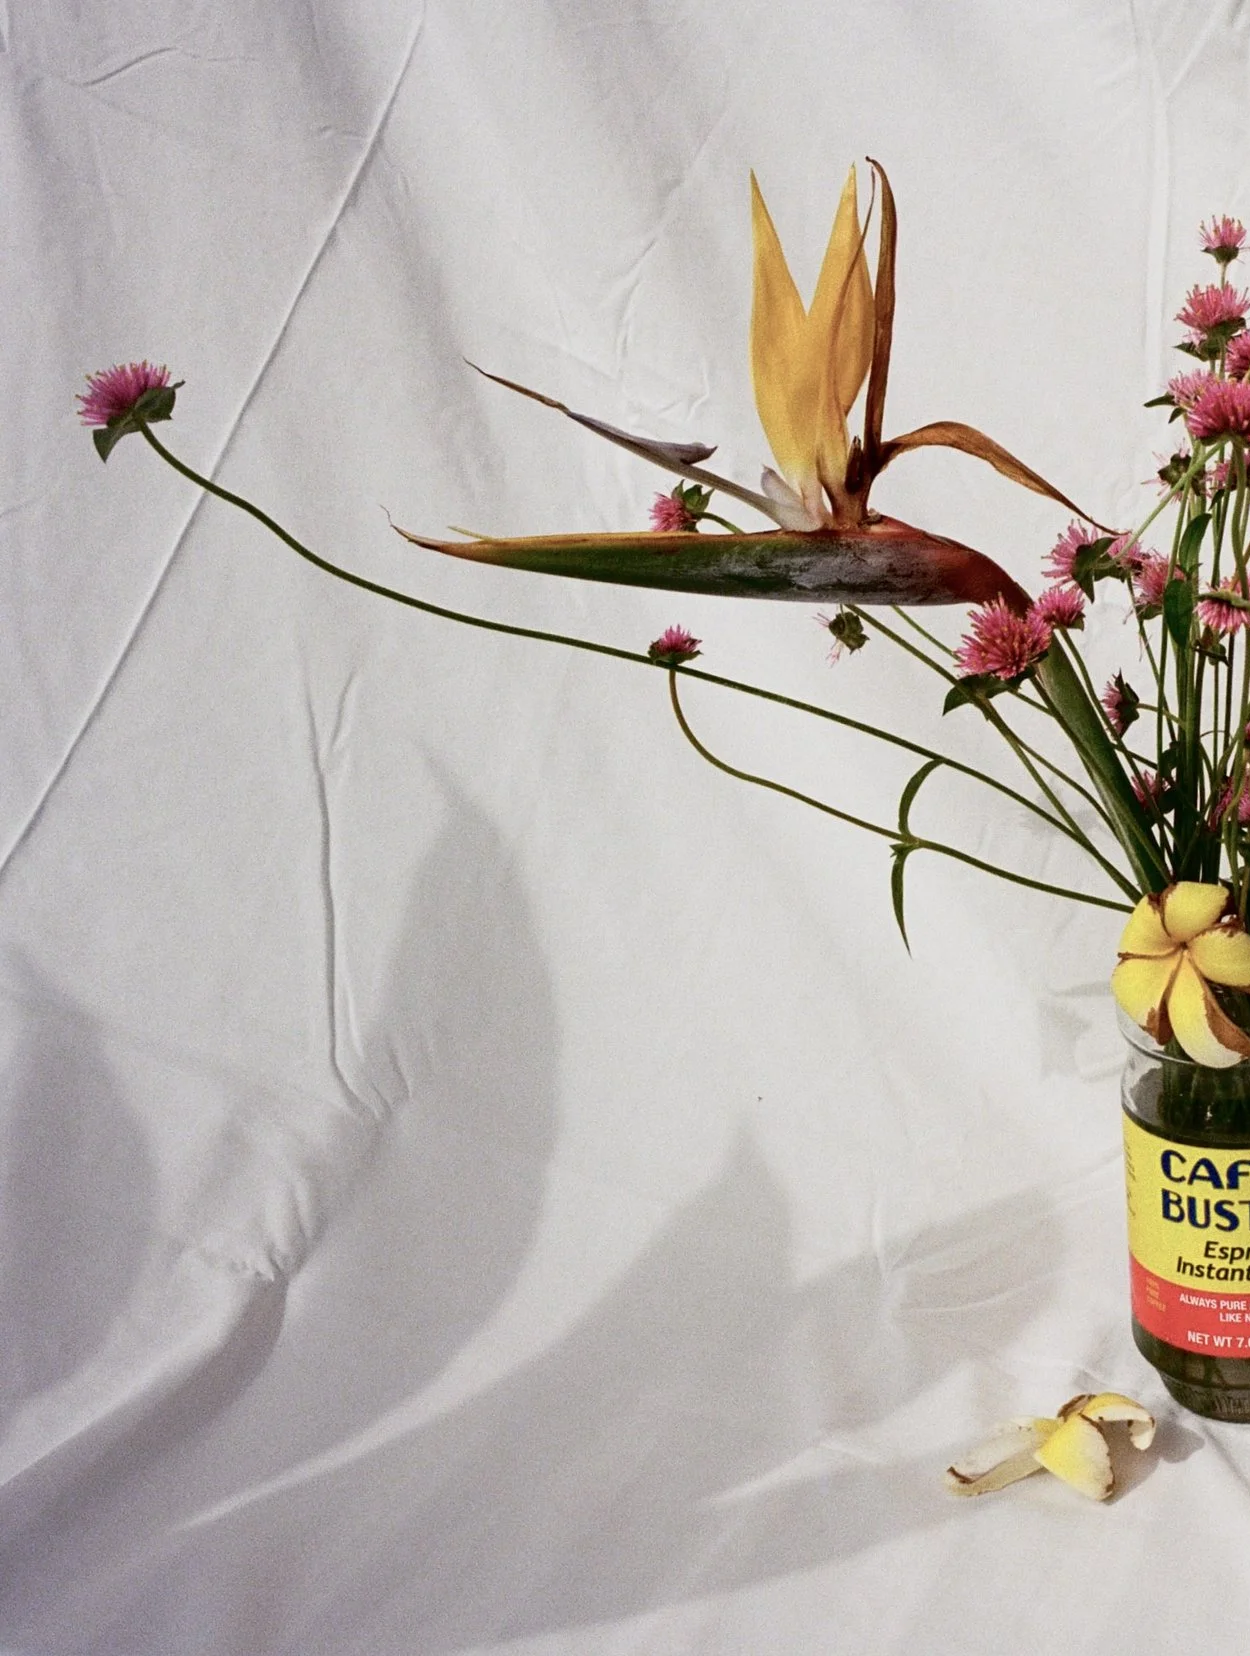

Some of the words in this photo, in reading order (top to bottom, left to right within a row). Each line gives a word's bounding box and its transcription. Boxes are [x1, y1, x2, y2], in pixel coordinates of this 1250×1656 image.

[1179, 1293, 1217, 1309] ALWAYS
[1220, 1301, 1247, 1310] PURE
[1219, 1313, 1242, 1323] LIKE
[1187, 1330, 1210, 1345] NET
[1213, 1336, 1233, 1348] WT
